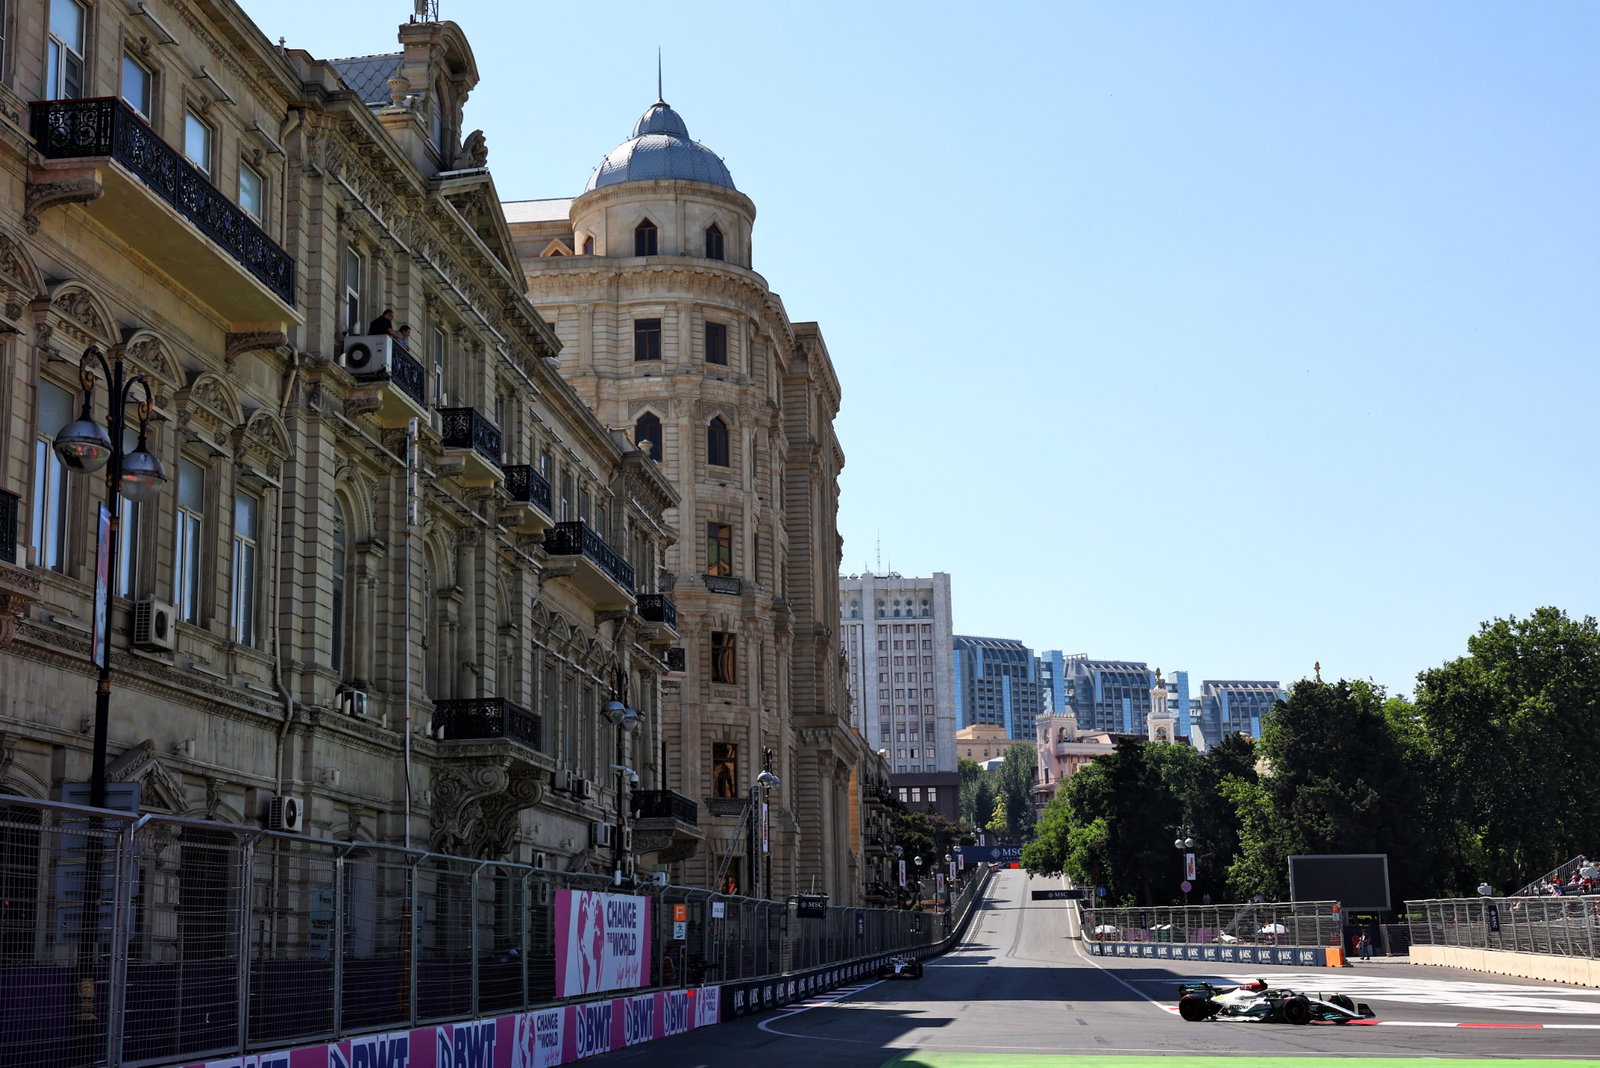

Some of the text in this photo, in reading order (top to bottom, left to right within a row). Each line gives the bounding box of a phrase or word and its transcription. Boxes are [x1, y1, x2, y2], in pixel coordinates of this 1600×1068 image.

[607, 901, 637, 929] CHANGE
[676, 906, 685, 920] F
[612, 933, 637, 957] WORLD
[537, 1013, 558, 1032] CHANGE
[633, 998, 654, 1040] BWT
[671, 994, 688, 1031] BWT
[541, 1032, 559, 1049] WORLD
[586, 1005, 611, 1052] BWT
[454, 1023, 495, 1068] BWT
